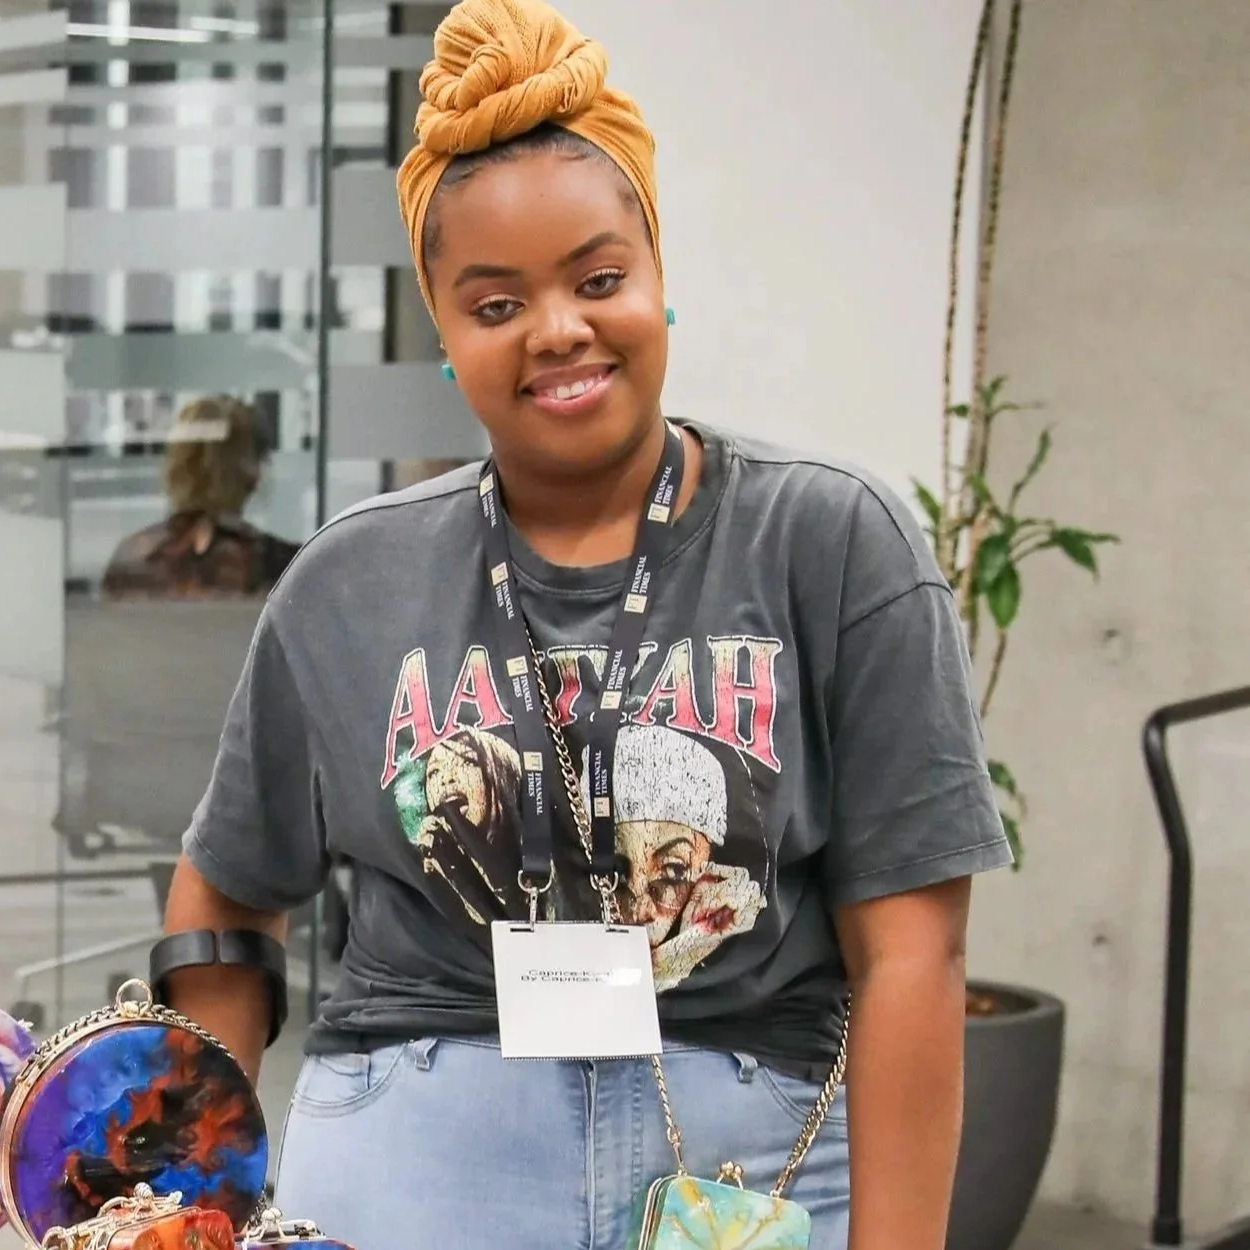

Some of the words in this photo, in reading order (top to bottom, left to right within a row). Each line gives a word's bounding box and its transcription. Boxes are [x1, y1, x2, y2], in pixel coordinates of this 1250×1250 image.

[654, 466, 672, 504] FINANCIAL
[661, 484, 674, 505] TIMES
[481, 495, 490, 518] TIMES
[487, 491, 498, 529] FINANCIAL
[631, 555, 647, 593] FINANCIAL
[639, 571, 651, 594] TIMES
[495, 584, 505, 608] TIMES
[502, 580, 515, 620] FINANCIAL
[607, 649, 623, 690] FINANCIAL
[614, 666, 627, 690] TIMES
[512, 676, 523, 698] TIMES
[520, 674, 533, 713] FINANCIAL
[381, 634, 784, 790] AAIAH
[527, 771, 536, 797] TIMES
[594, 750, 602, 795] FINANCIAL
[535, 772, 544, 816] FINANCIAL
[521, 975, 537, 983] By
[528, 969, 611, 978] Caprice-K
